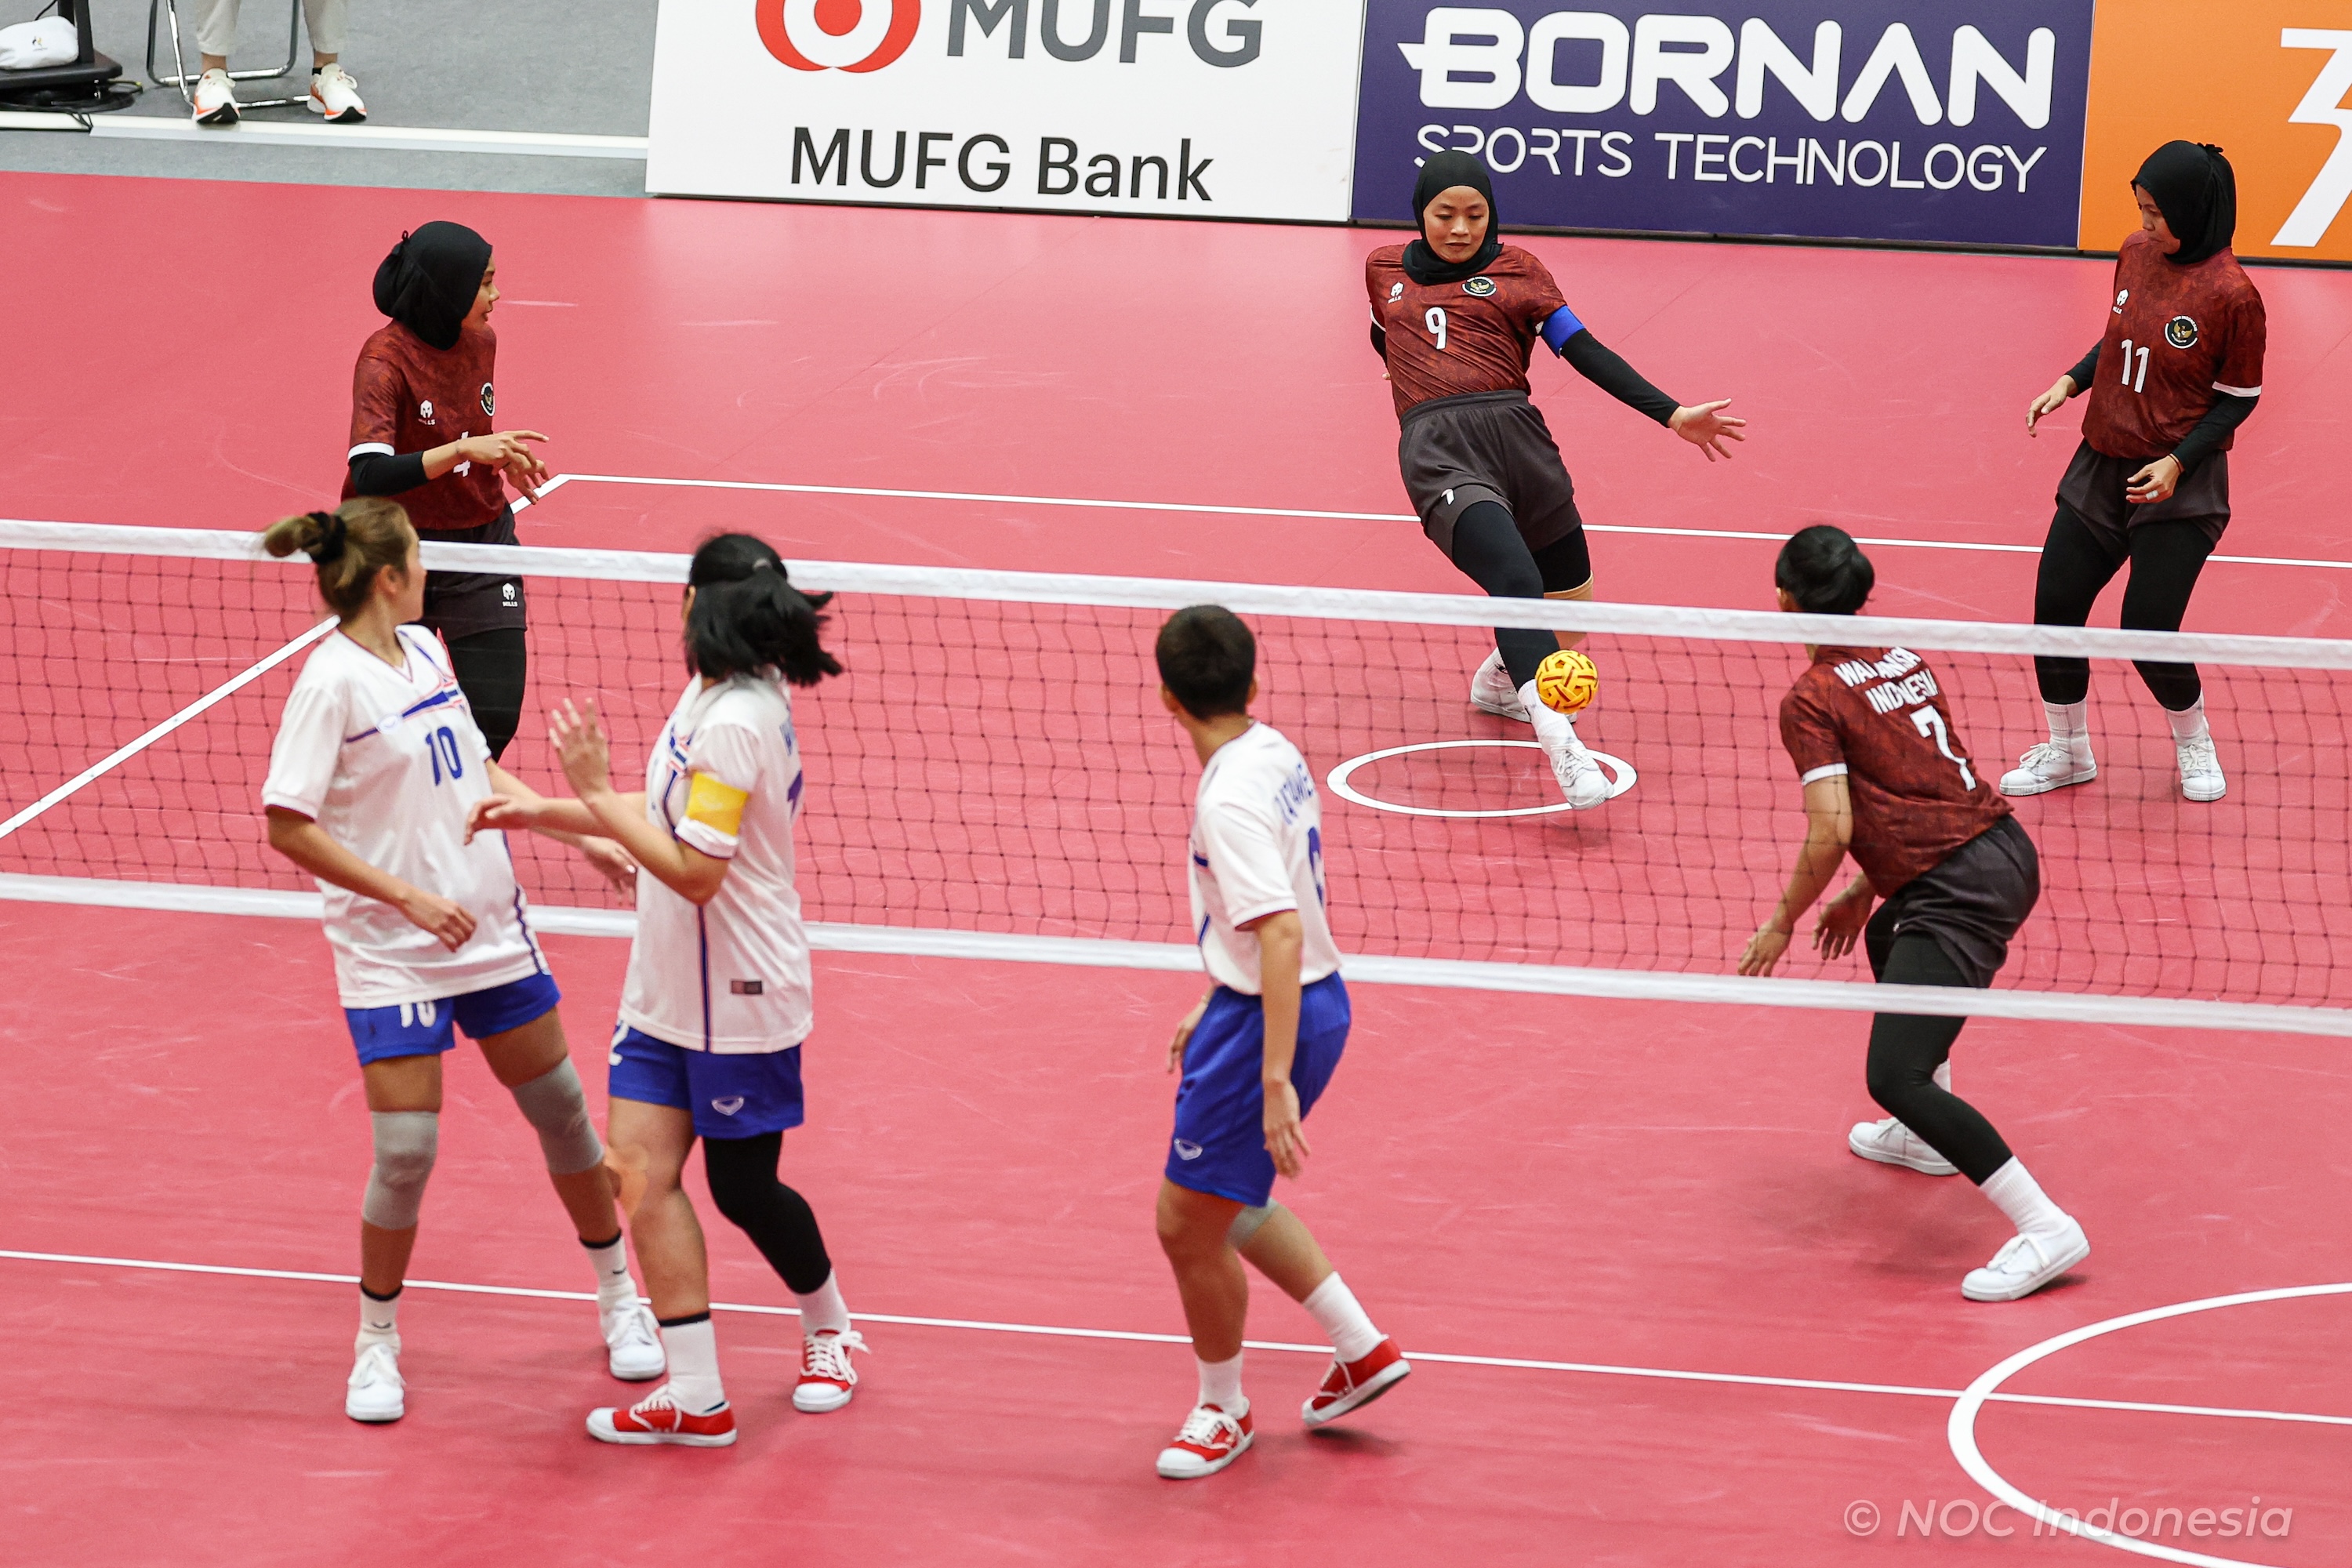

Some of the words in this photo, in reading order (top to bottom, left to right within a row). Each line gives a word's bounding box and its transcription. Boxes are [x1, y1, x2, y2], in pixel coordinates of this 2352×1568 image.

[947, 0, 1263, 68] MUFG
[1396, 7, 2056, 130] BORNAN
[790, 126, 1011, 193] MUFG
[1037, 136, 1214, 201] Bank
[1654, 132, 2047, 193] TECHNOLOGY
[1425, 307, 1447, 350] 9
[2121, 339, 2150, 394] 11
[425, 726, 463, 786] 10
[1909, 704, 1976, 791] 7
